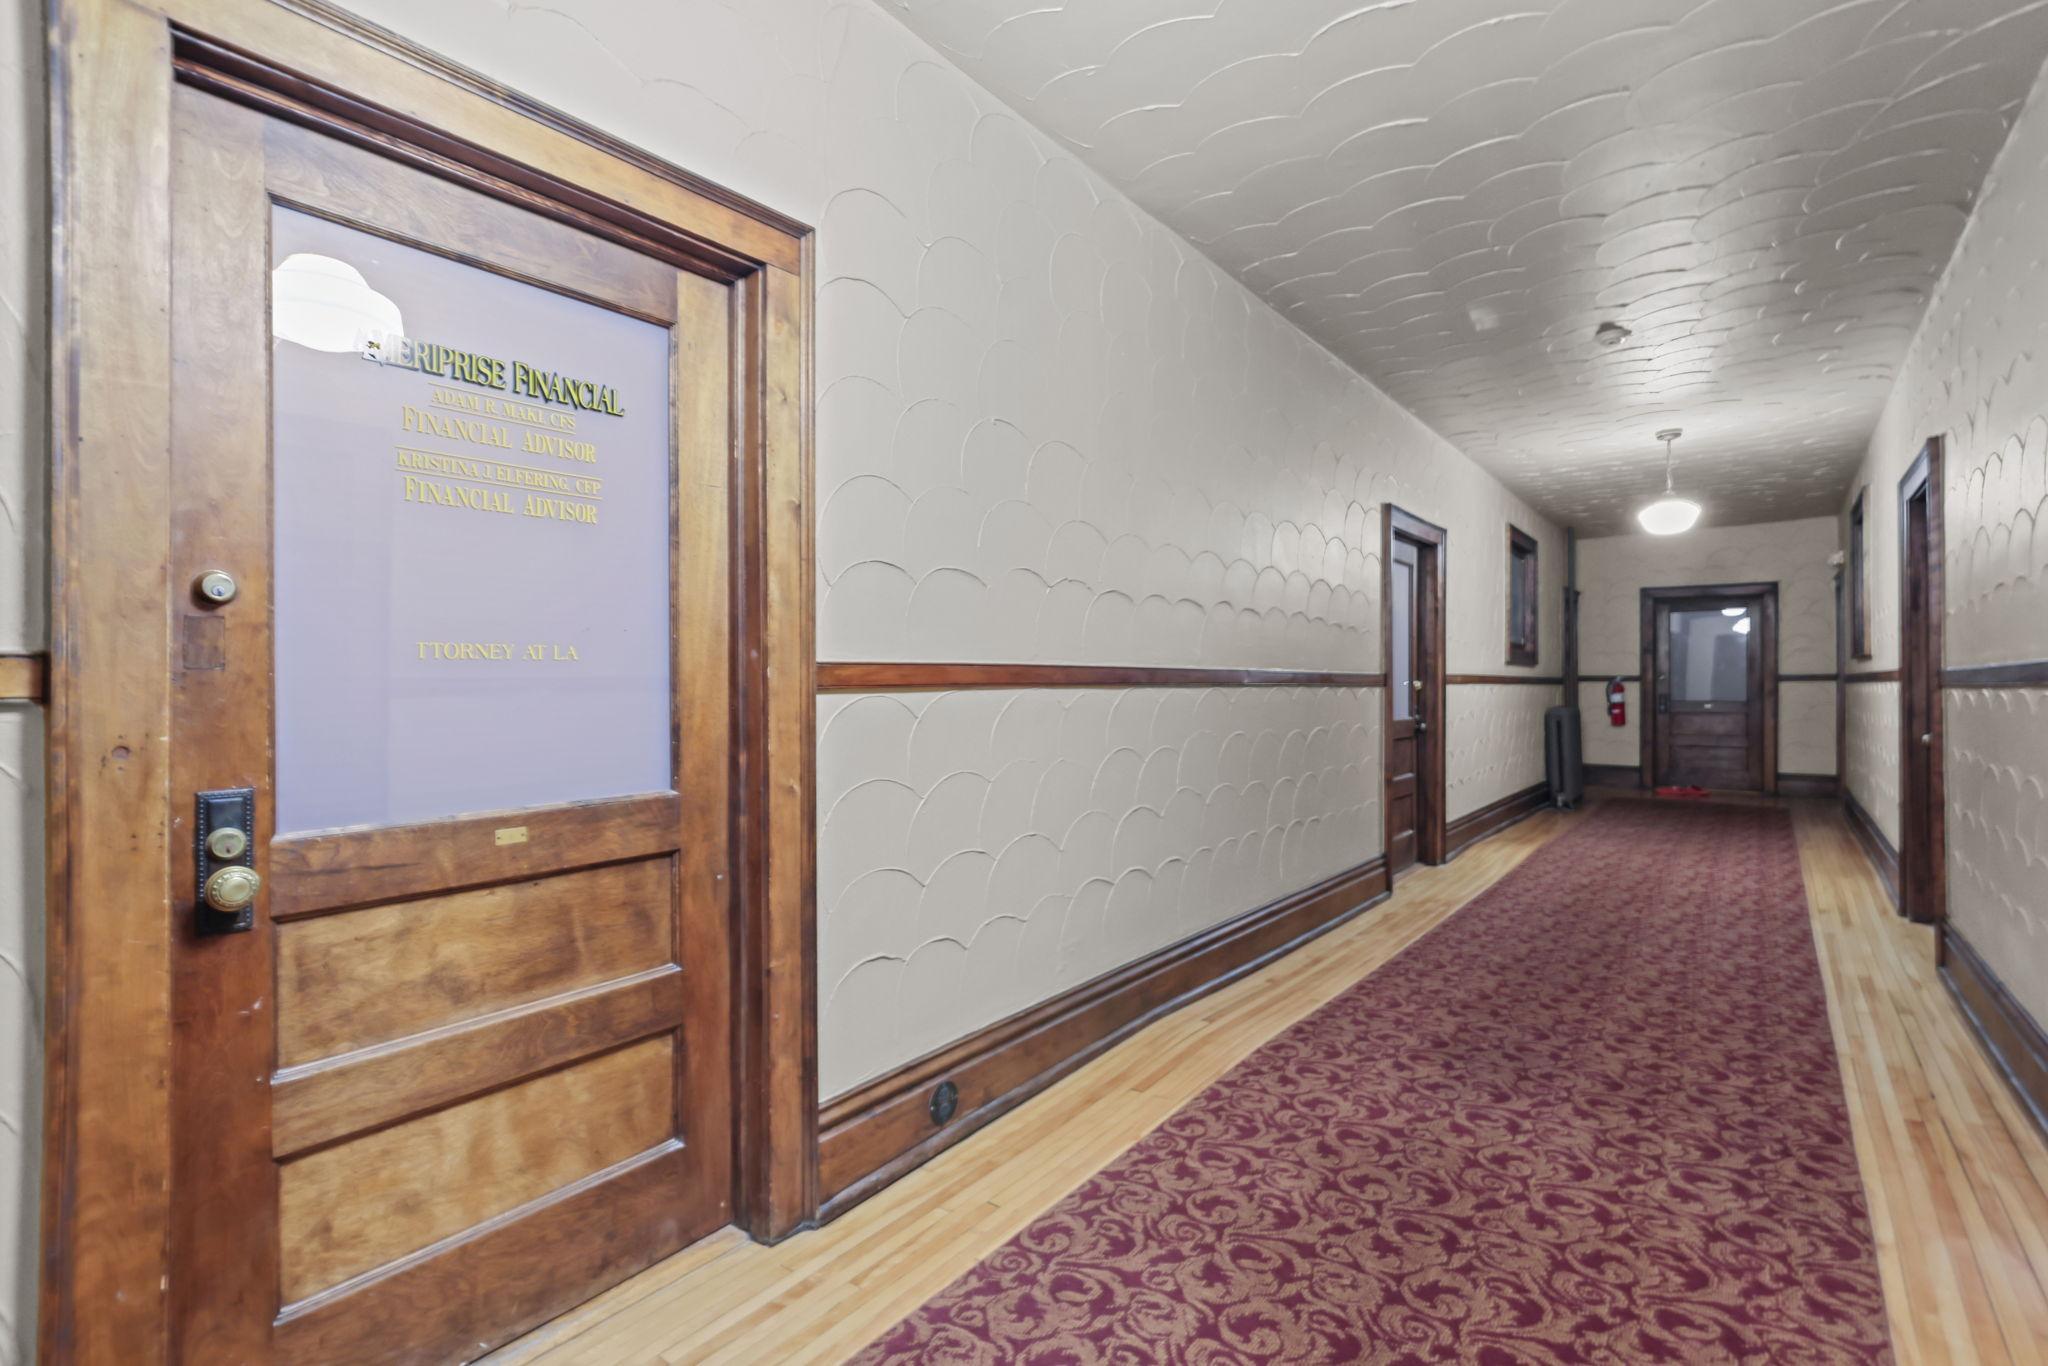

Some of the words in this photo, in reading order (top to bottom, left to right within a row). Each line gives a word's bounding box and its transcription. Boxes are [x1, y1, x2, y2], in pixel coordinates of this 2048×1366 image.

[360, 332, 507, 389] ERIPRISE
[512, 360, 624, 416] FINANCIAL
[432, 389, 479, 412] ADAM
[402, 405, 513, 449] FINANCIAL
[522, 431, 597, 463] ADVISOR
[397, 451, 479, 477] KRISTINA
[576, 479, 601, 495] CFP
[403, 476, 514, 515] FINANCIAL
[523, 495, 598, 524] ADVISOR
[522, 644, 547, 660] AT
